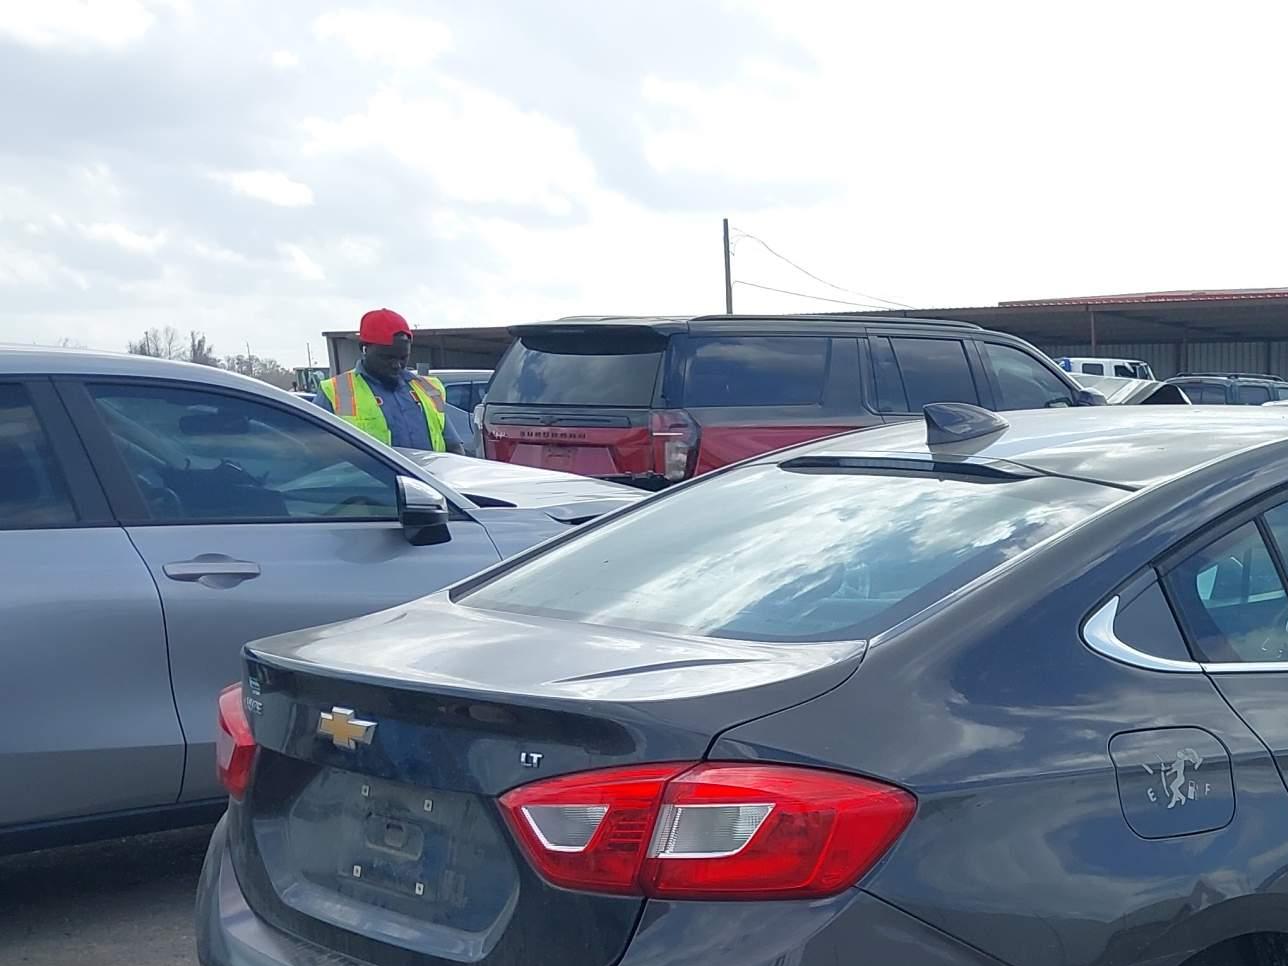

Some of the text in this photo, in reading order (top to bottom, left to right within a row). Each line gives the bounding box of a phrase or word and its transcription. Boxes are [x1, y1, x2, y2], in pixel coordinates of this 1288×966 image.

[520, 752, 543, 768] LT
[1147, 783, 1211, 802] E F
